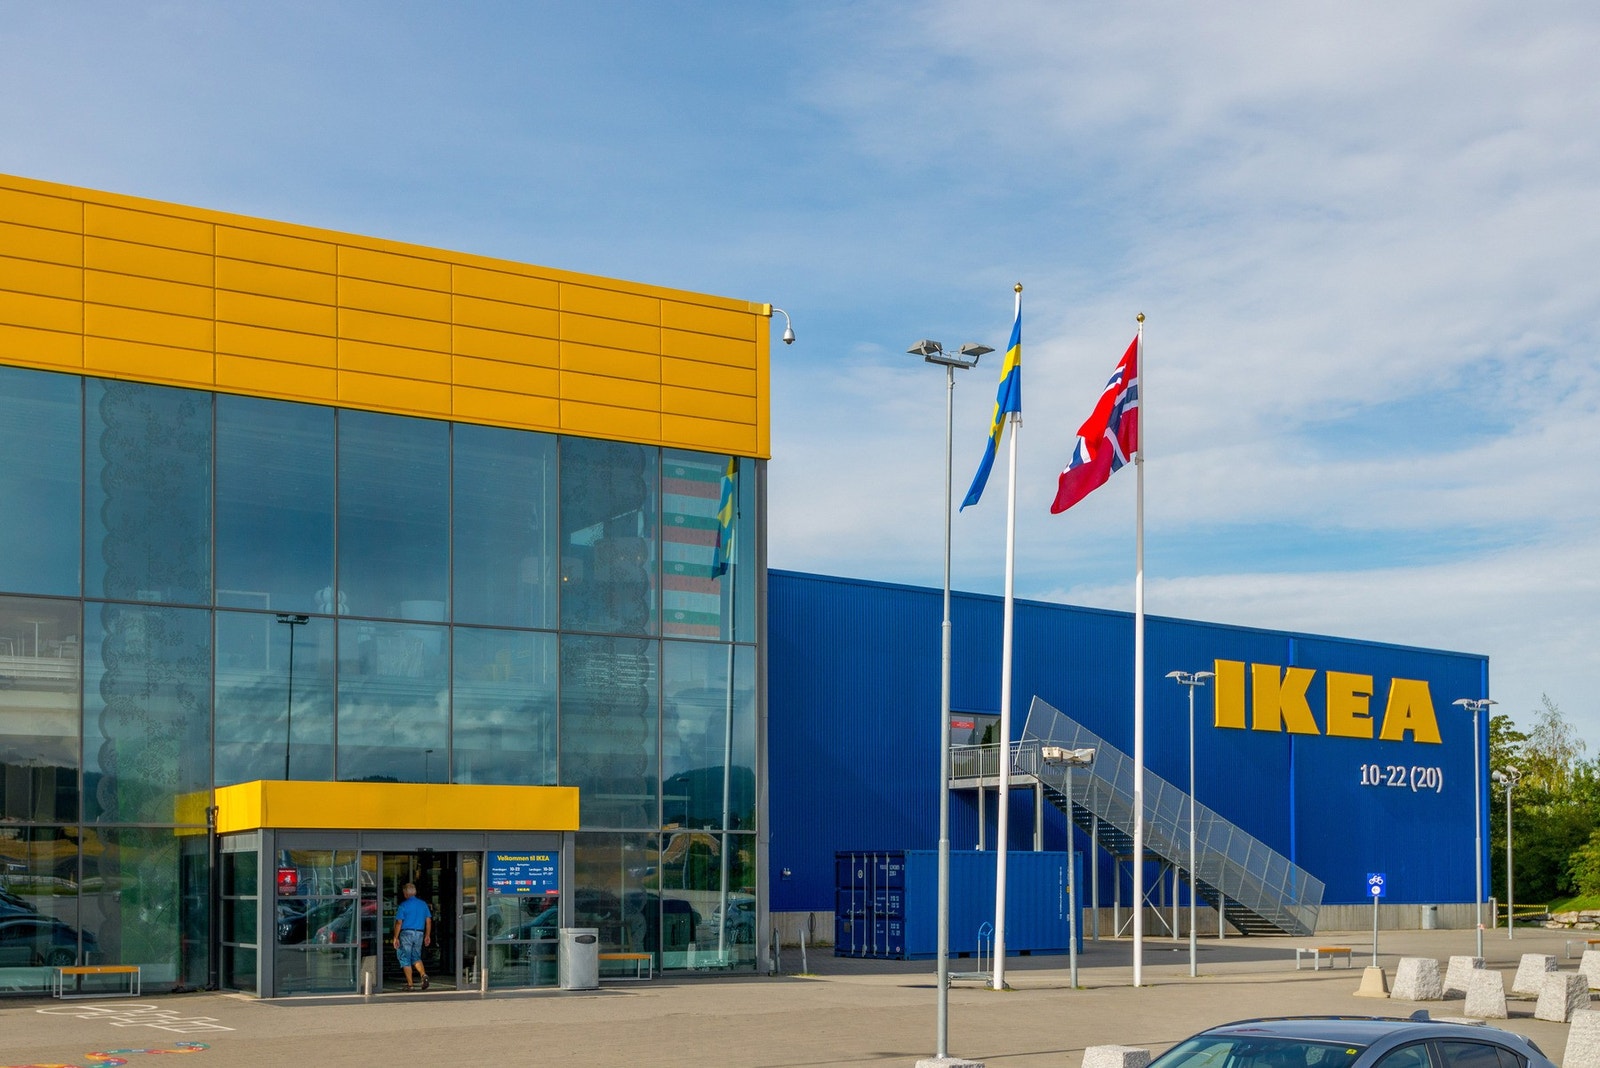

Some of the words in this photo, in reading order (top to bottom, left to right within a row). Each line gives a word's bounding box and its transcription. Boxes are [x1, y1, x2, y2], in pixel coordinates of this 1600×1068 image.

[1213, 658, 1442, 744] IKEA
[1360, 763, 1406, 787] 10-22
[1410, 766, 1443, 793] (20)
